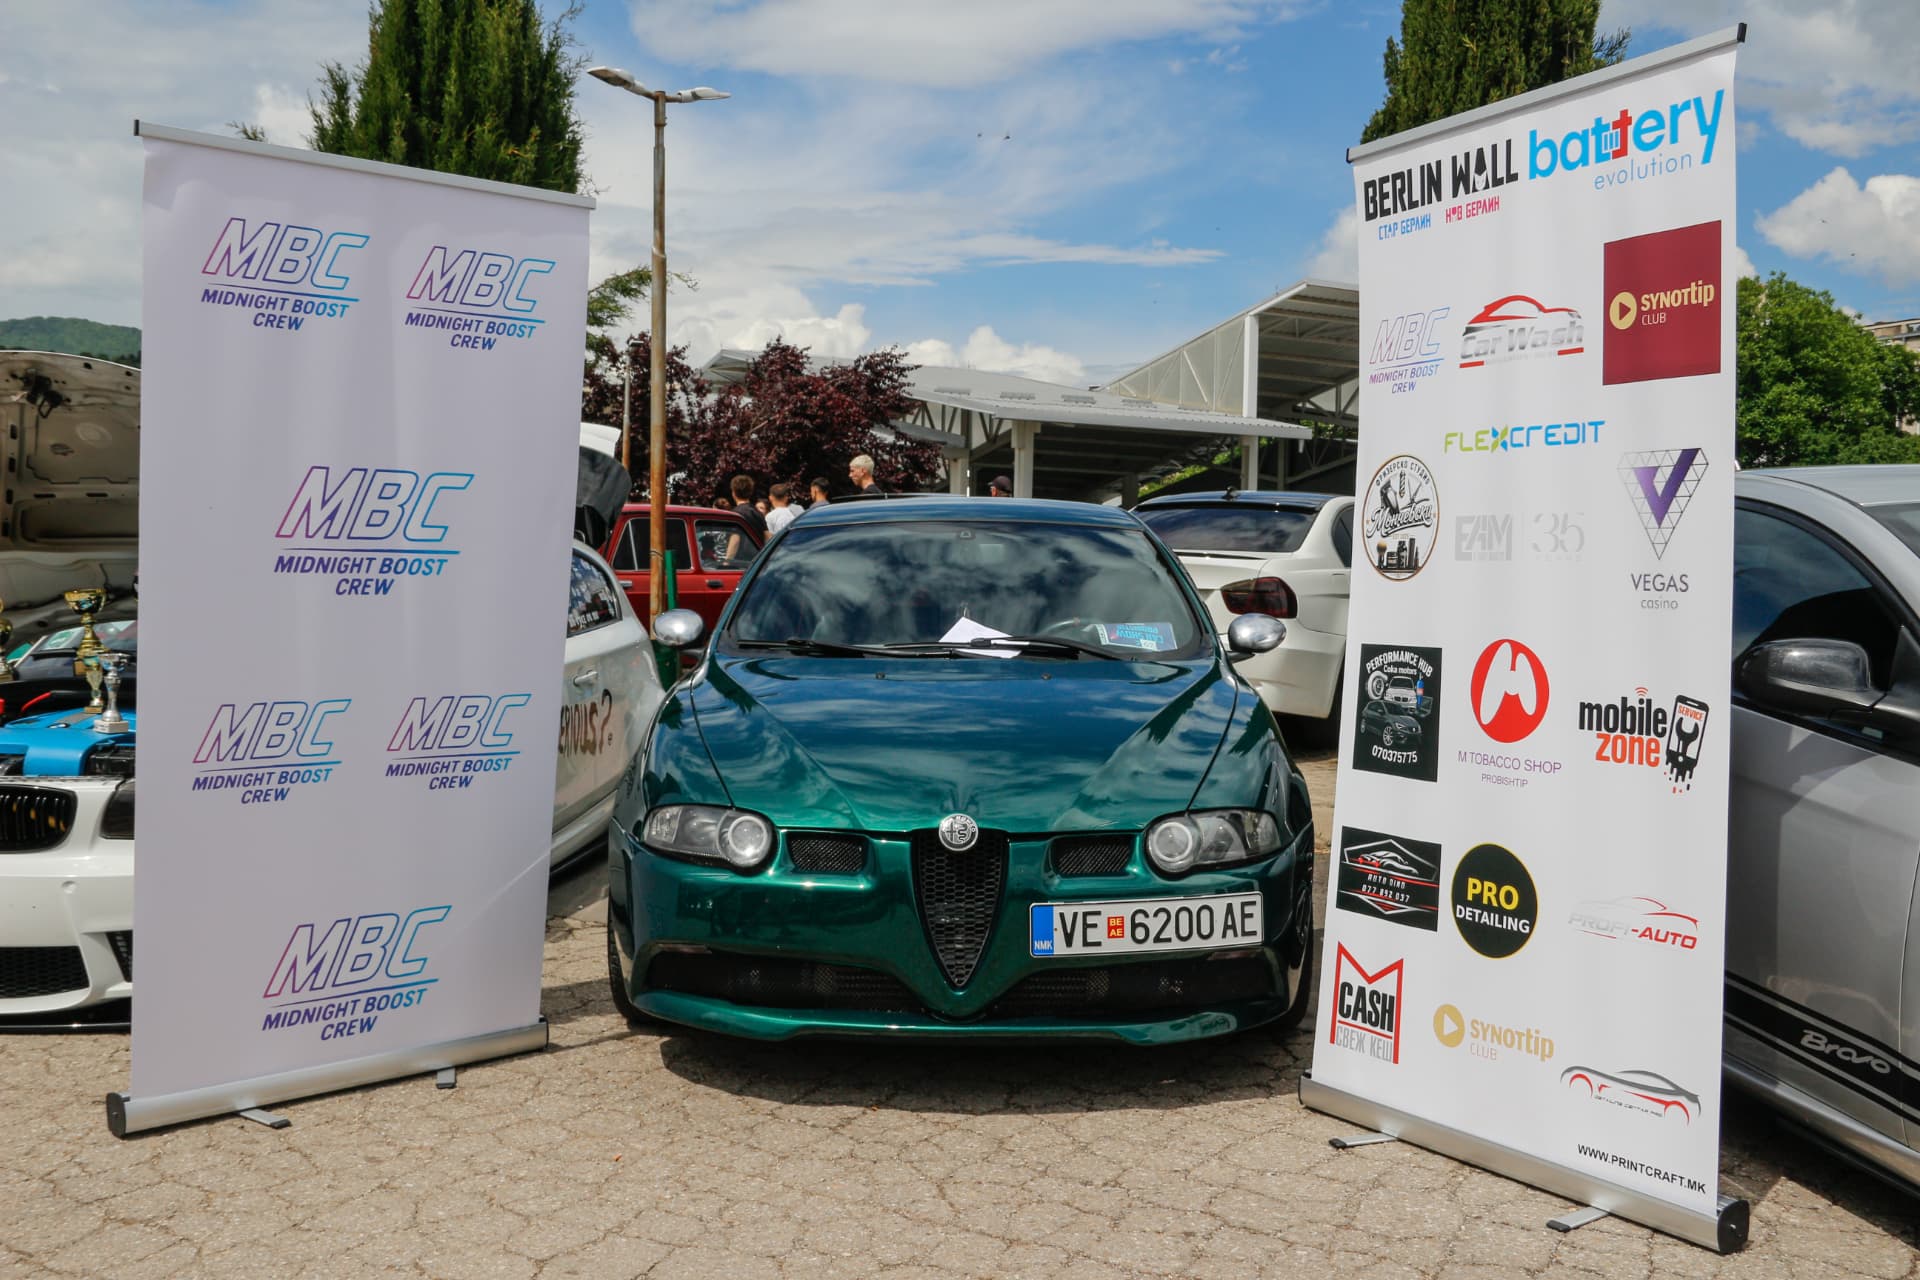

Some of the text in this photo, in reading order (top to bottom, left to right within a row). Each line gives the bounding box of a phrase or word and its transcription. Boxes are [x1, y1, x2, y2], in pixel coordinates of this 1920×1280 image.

[1528, 89, 1725, 181] battery
[1364, 139, 1519, 223] BERLIN WALL
[1594, 153, 1692, 190] evolution
[201, 217, 370, 290] MBC
[406, 245, 556, 313] MBC
[201, 288, 349, 319] MIDNIGHT BOOST
[252, 311, 304, 331] CREW
[404, 312, 536, 339] MIDNIGHT BOOST
[1641, 312, 1667, 327] CLUB
[450, 333, 496, 351] CREW
[1369, 307, 1450, 365] MBC
[1369, 364, 1440, 384] MIDNIGHT BOOST
[1391, 381, 1417, 395] CREW
[274, 465, 474, 542] MBC
[274, 555, 448, 576] MIDNIGHT BOOST
[335, 578, 394, 596] CREW
[1630, 573, 1689, 594] VEGAS
[1640, 595, 1679, 610] casino
[1366, 650, 1433, 677] PERFORMANCE HUB
[387, 693, 532, 752] MBC
[1579, 696, 1667, 738] mobile
[1678, 705, 1704, 721] SERVICE
[192, 698, 352, 764] MBC
[1372, 745, 1418, 764] 070375775
[1458, 750, 1562, 774] M TOBACCO SHOP
[1595, 732, 1661, 768] zone
[192, 767, 332, 791] MIDNIGHT BOOST
[385, 757, 512, 777] MIDNIGHT BOOST
[1481, 773, 1528, 788] PROBISHTIP
[240, 787, 290, 805] CREW
[429, 775, 473, 790] CREW
[1466, 876, 1519, 910] PRO
[1059, 901, 1258, 948] VE 6200 AE
[1455, 904, 1530, 934] DETAILING
[263, 905, 452, 998] MBC
[1034, 941, 1053, 950] NMK
[262, 988, 428, 1031] MIDNIGHT BOOST
[1338, 981, 1396, 1033] CASH
[320, 1015, 378, 1042] CREW
[1336, 1025, 1393, 1062] СВЕЖ КЕШ
[1470, 1042, 1497, 1061] CLUB
[1800, 1029, 1891, 1074] Bravo
[1577, 1143, 1707, 1195] WWW.PRINTCRAFT.MK
